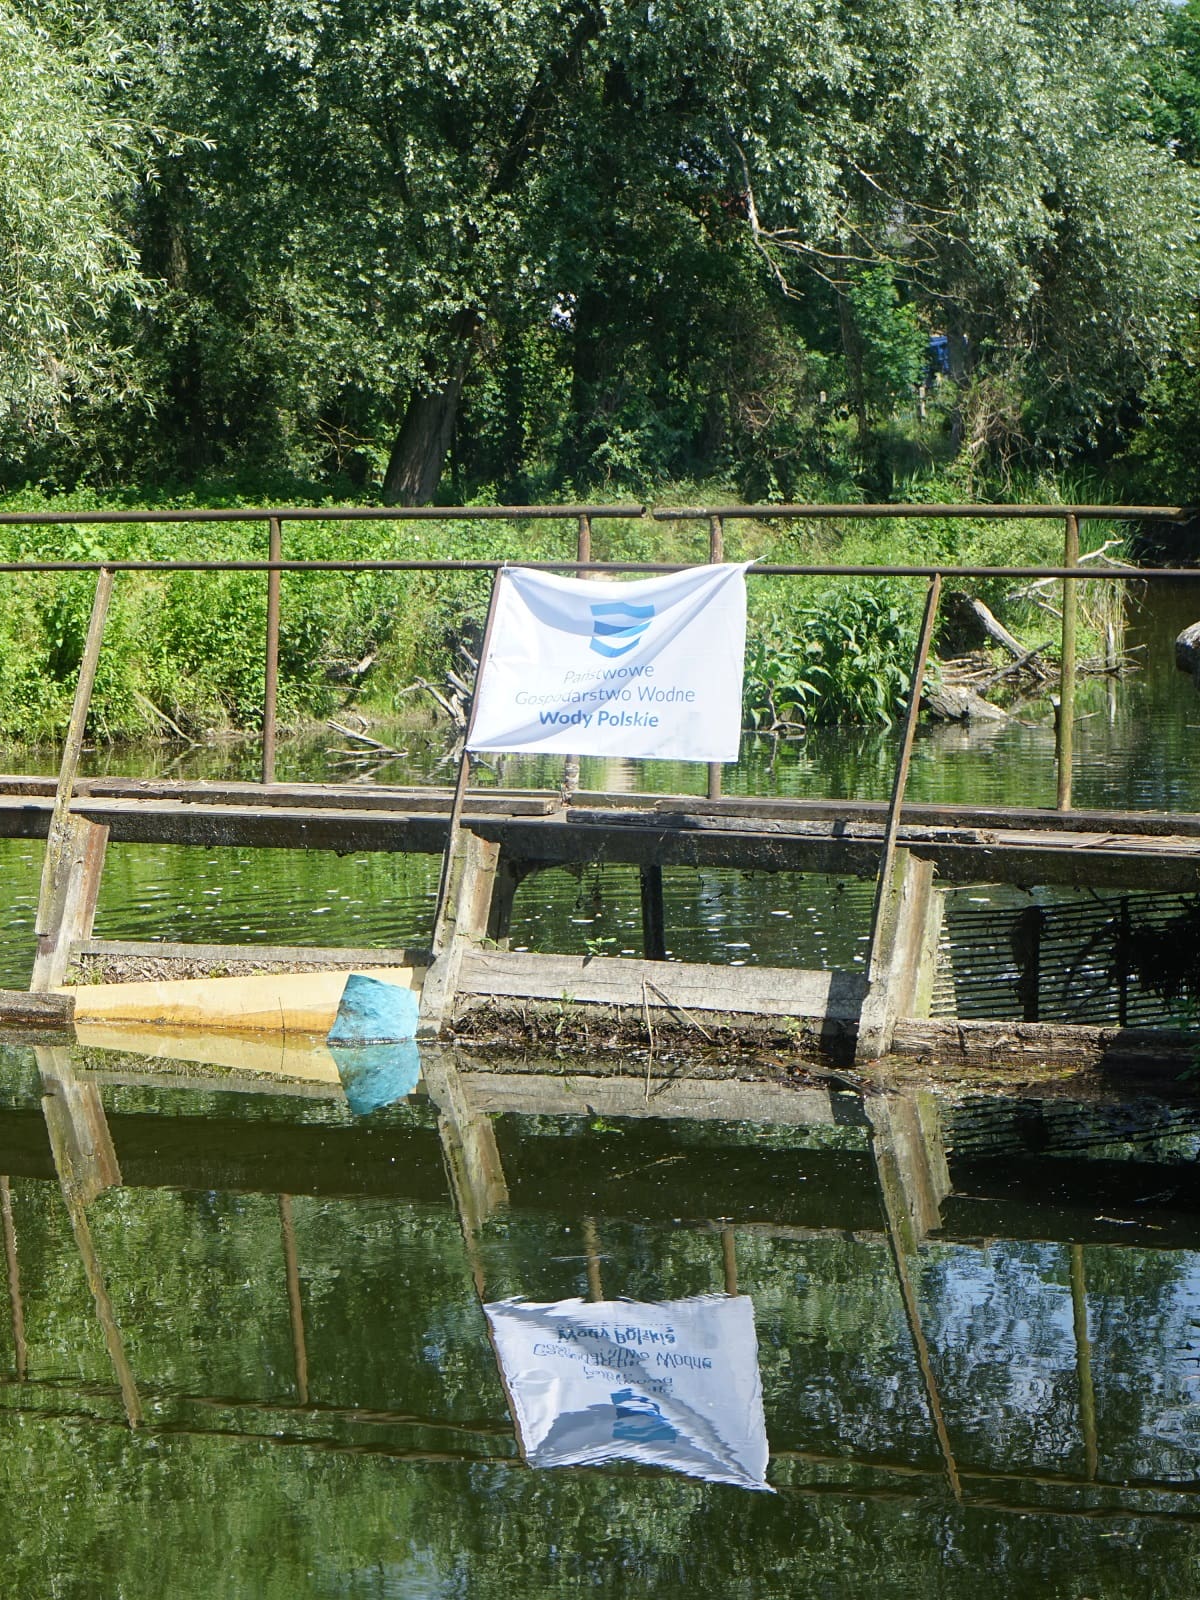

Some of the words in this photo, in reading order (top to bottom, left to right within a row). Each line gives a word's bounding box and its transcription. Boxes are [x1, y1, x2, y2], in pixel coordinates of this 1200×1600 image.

[637, 686, 696, 702] Wodne
[539, 709, 593, 728] Wody
[597, 710, 660, 727] Polskie
